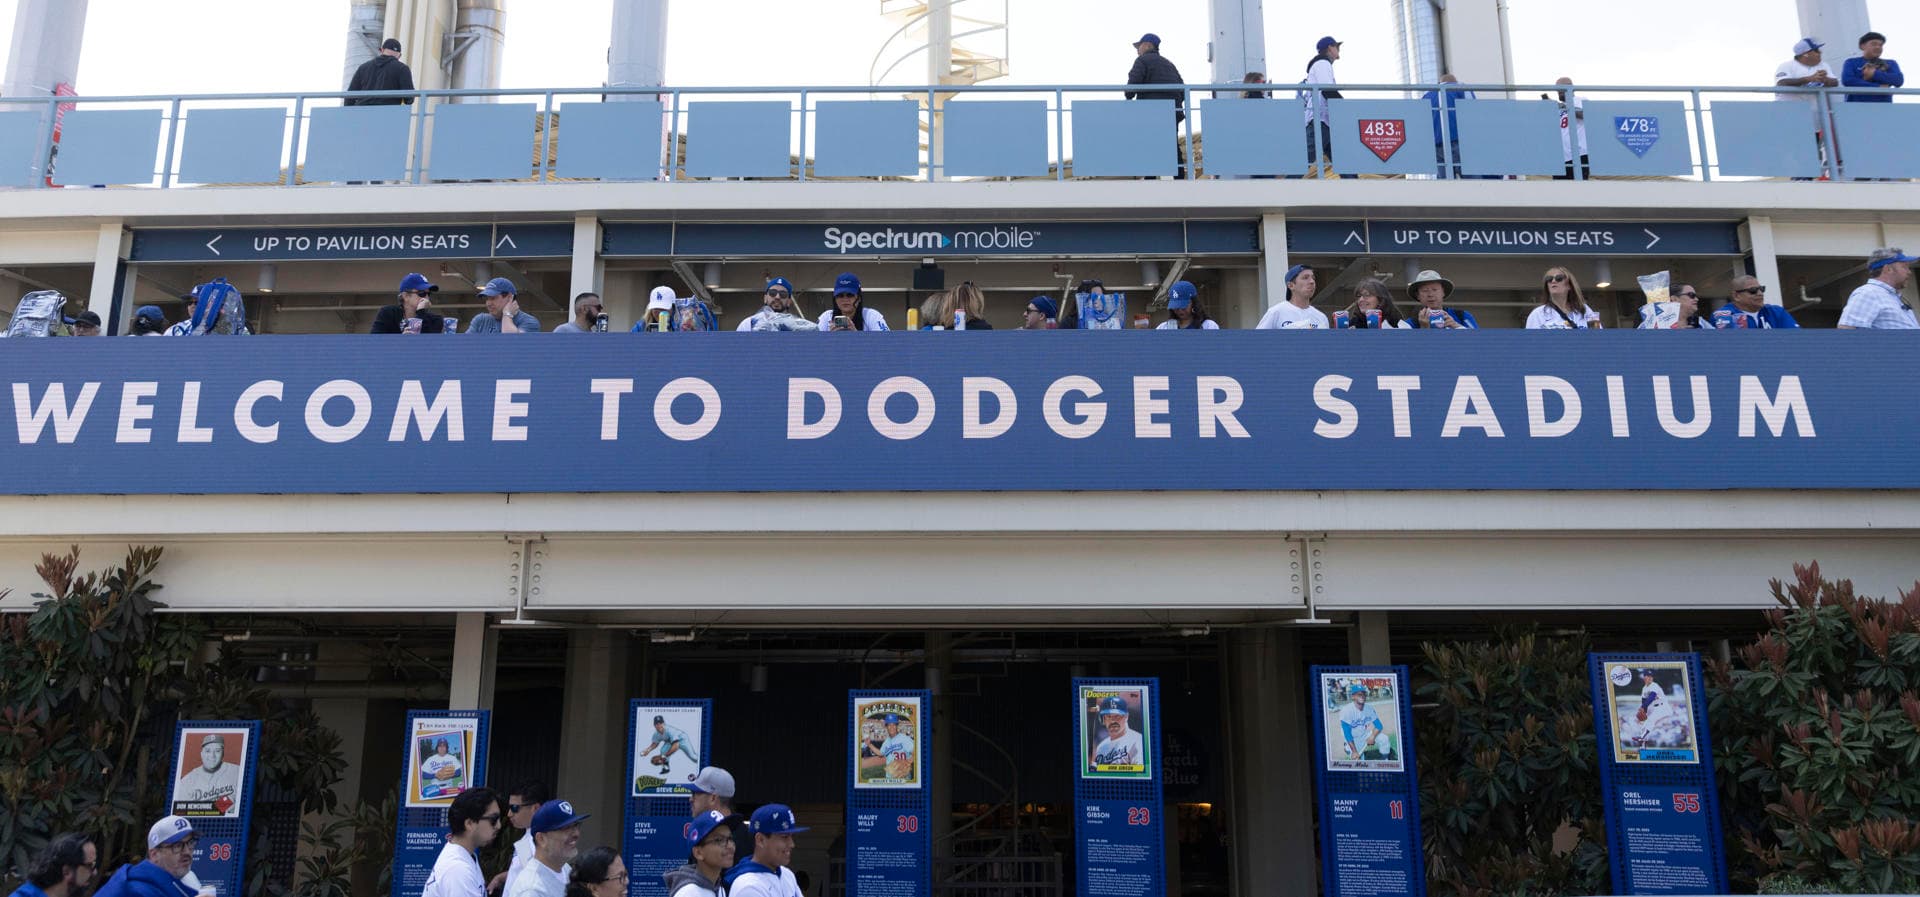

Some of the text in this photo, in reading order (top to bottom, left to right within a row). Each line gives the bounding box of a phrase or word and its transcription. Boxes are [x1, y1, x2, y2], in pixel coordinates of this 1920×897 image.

[1364, 122, 1395, 136] 483
[1620, 118, 1649, 132] 478
[253, 234, 470, 252] UP TO PAVILION SEATS
[823, 227, 942, 254] Spectrum
[1393, 230, 1614, 246] UP TO PAVILION SEATS
[10, 373, 1818, 444] WELCOME TO DODGER STADIUM
[1361, 678, 1392, 688] DODGERS
[1086, 690, 1120, 698] DODGERS
[863, 703, 913, 715] DODGERS
[192, 783, 234, 800] Dodgers
[1389, 800, 1403, 819] 11
[1623, 798, 1660, 806] HERSHISER
[1672, 792, 1700, 813] 55
[896, 815, 919, 833] 30
[1127, 807, 1150, 826] 23
[209, 843, 231, 861] 36
